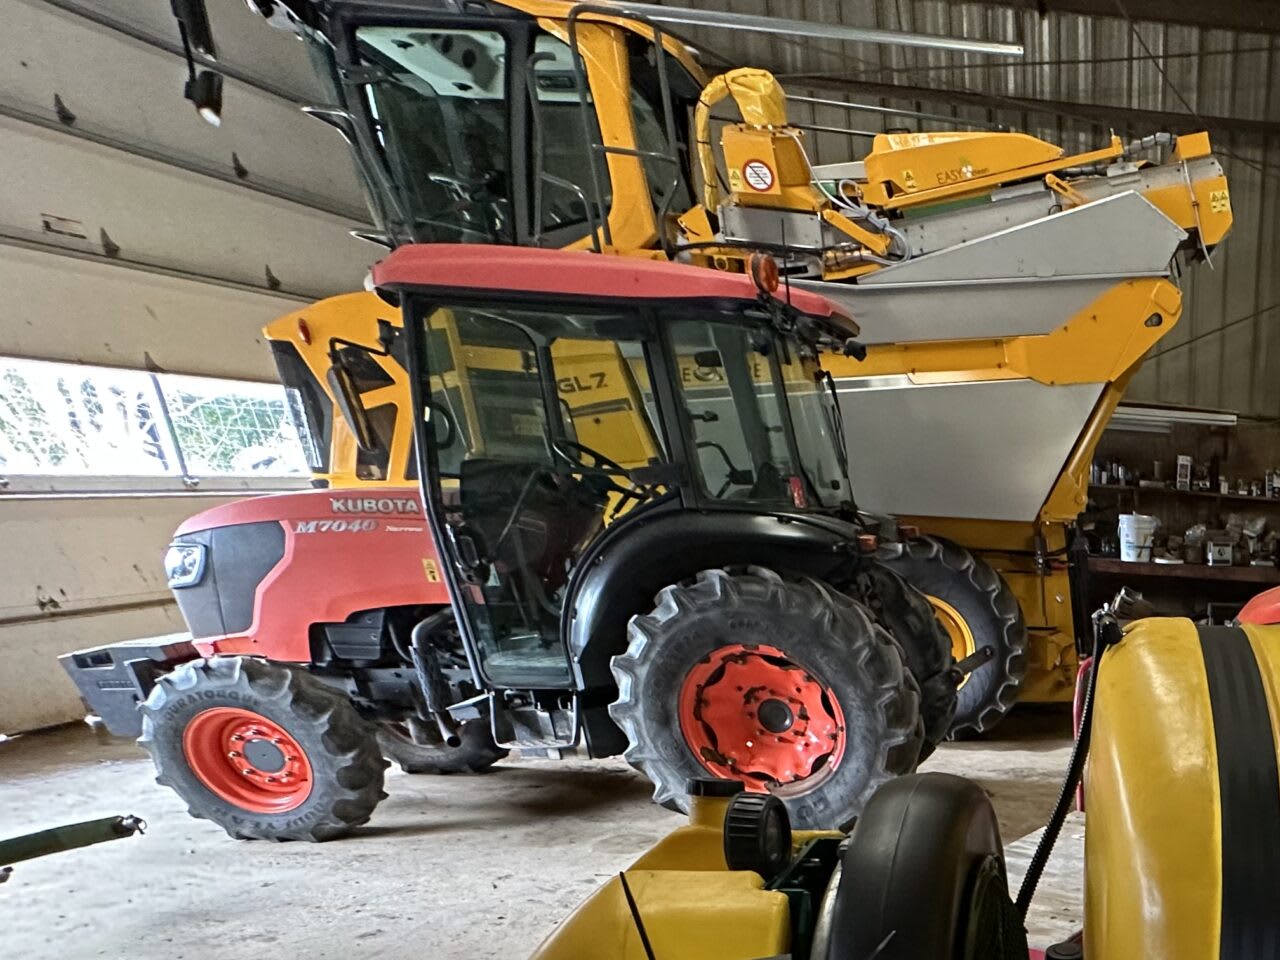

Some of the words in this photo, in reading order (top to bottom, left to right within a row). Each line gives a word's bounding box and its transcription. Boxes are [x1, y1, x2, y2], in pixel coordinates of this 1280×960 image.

[936, 168, 962, 185] EASY
[331, 498, 420, 514] KUBOTA
[296, 519, 379, 533] M7040
